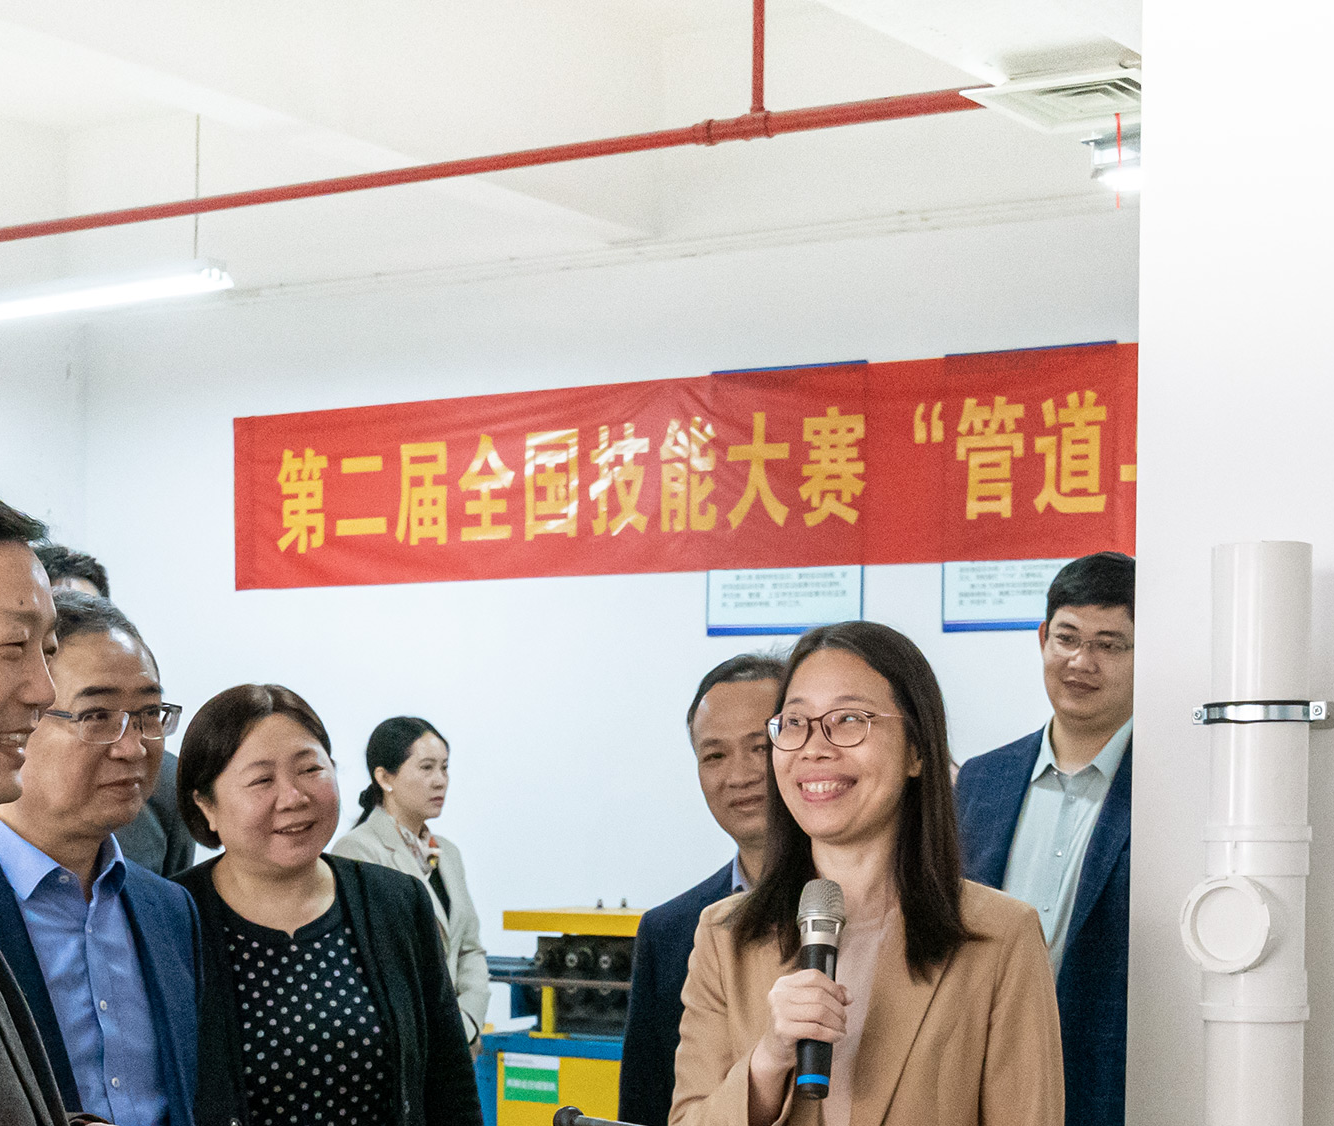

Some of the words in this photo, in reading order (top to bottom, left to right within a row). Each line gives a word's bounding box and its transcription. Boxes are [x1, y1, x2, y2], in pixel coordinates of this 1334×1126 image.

[277, 391, 1137, 553] 第二届全国技能大赛“管道
